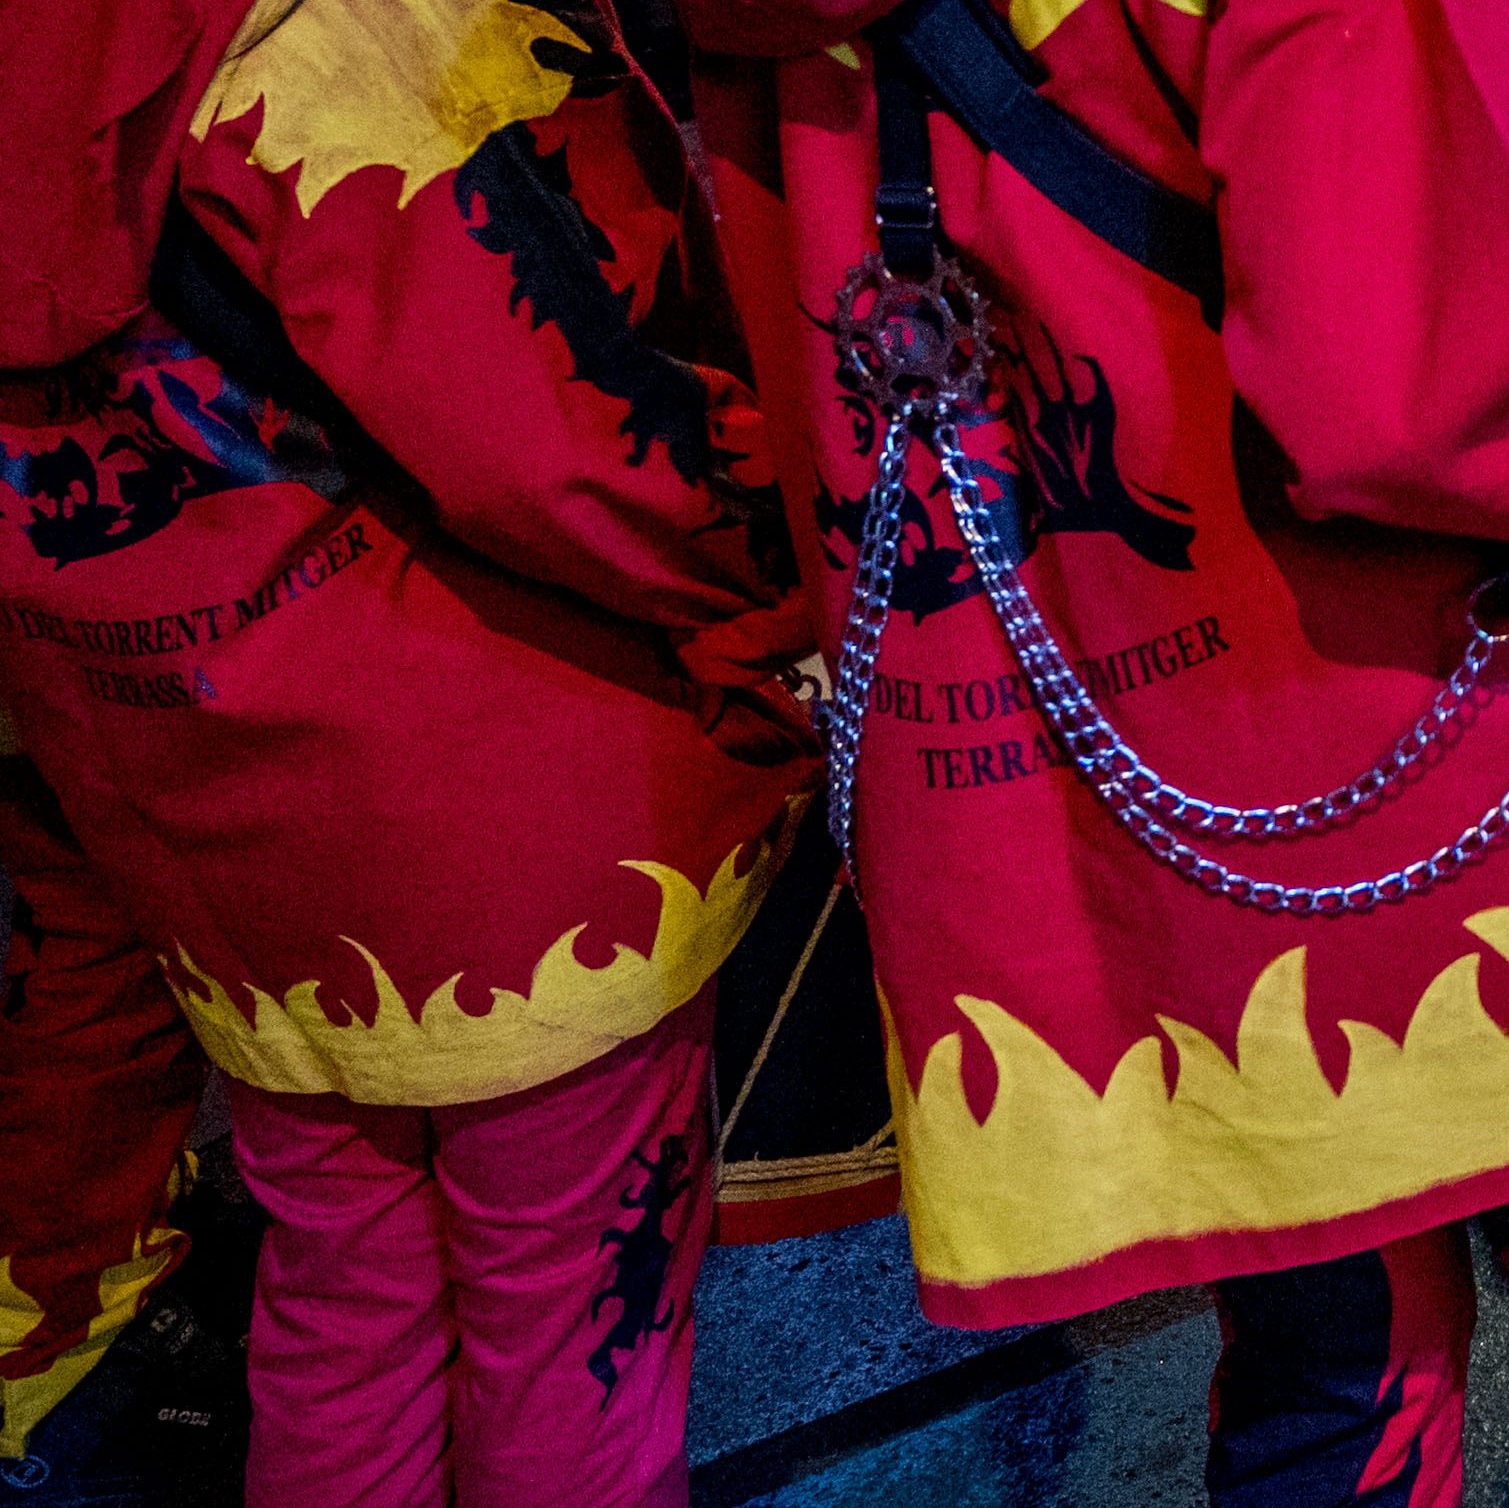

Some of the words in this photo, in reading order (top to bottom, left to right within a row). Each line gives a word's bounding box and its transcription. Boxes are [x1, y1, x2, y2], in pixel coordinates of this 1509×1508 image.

[74, 603, 224, 658] TORRENT
[233, 522, 374, 630] MITGER
[80, 661, 218, 710] TERRASSA
[874, 672, 935, 724] DEL
[1090, 615, 1230, 701] MITGER
